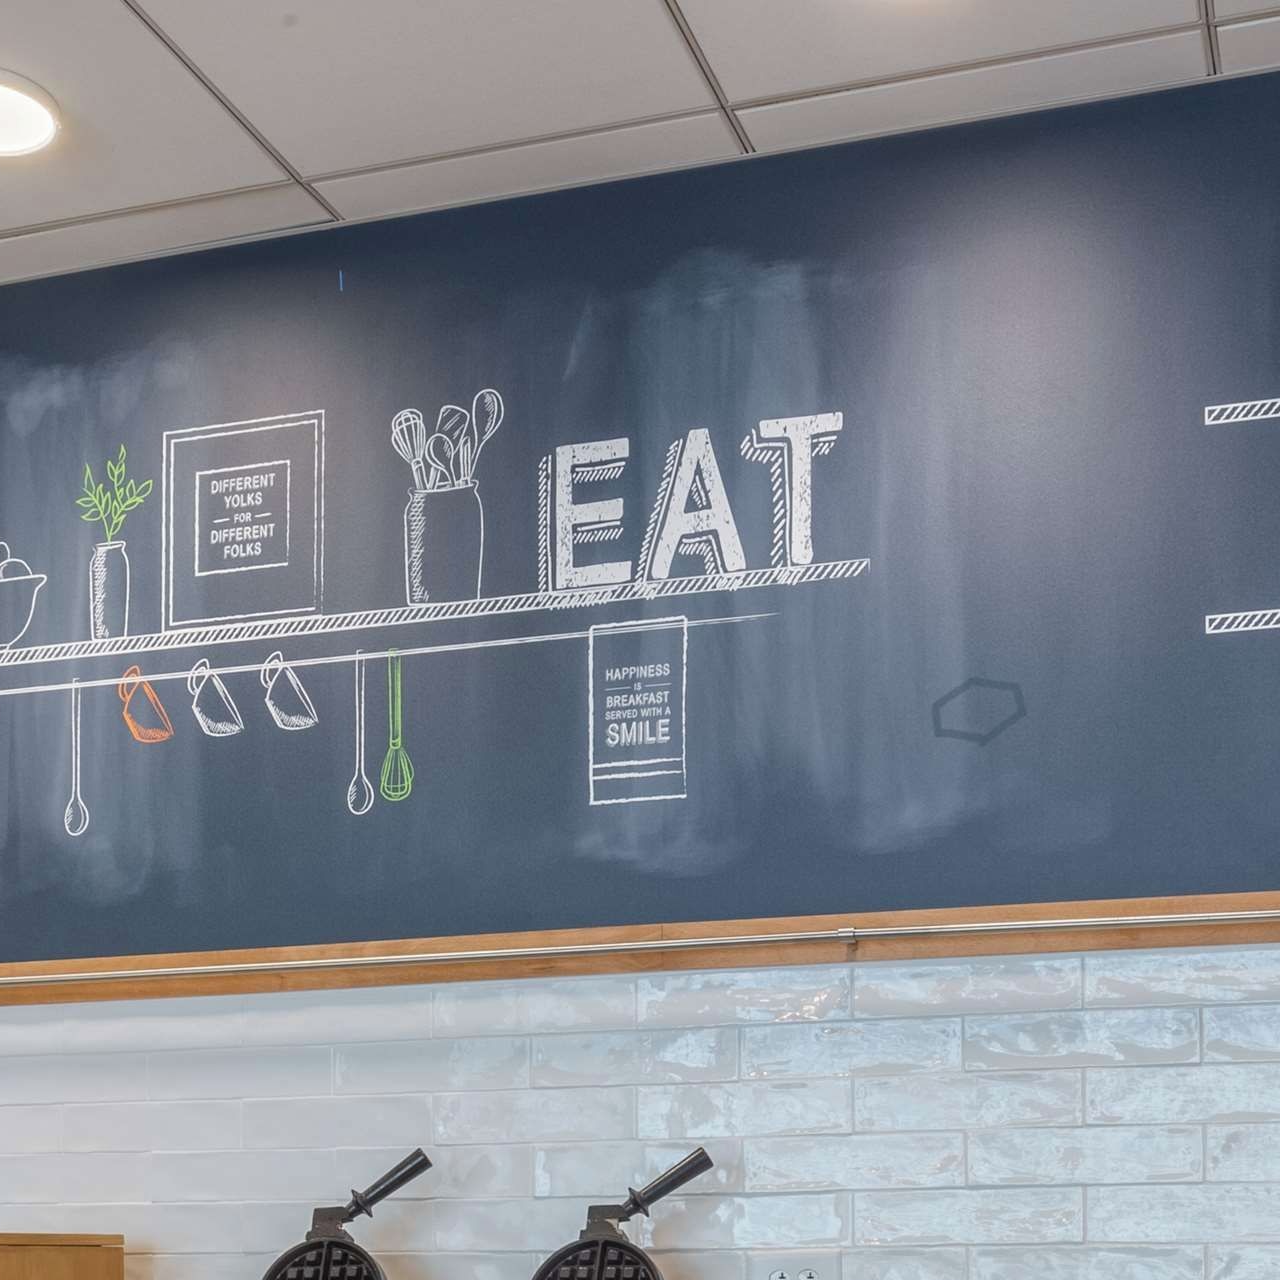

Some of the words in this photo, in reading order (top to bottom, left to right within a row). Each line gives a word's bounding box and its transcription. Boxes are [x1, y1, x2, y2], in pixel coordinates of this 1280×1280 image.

[211, 473, 276, 494] DIFFERENT
[224, 491, 263, 509] YOLKS
[546, 411, 844, 591] EAT
[233, 512, 252, 524] FOR
[210, 523, 276, 544] DIFFERENT
[223, 541, 262, 559] FOLKS
[605, 663, 671, 681] HAPPINESS
[633, 682, 642, 691] IS
[606, 690, 671, 708] BREAKFAST
[604, 709, 638, 721] SERVED
[640, 707, 662, 717] WITH
[664, 706, 672, 716] A
[606, 718, 671, 747] SMILE
